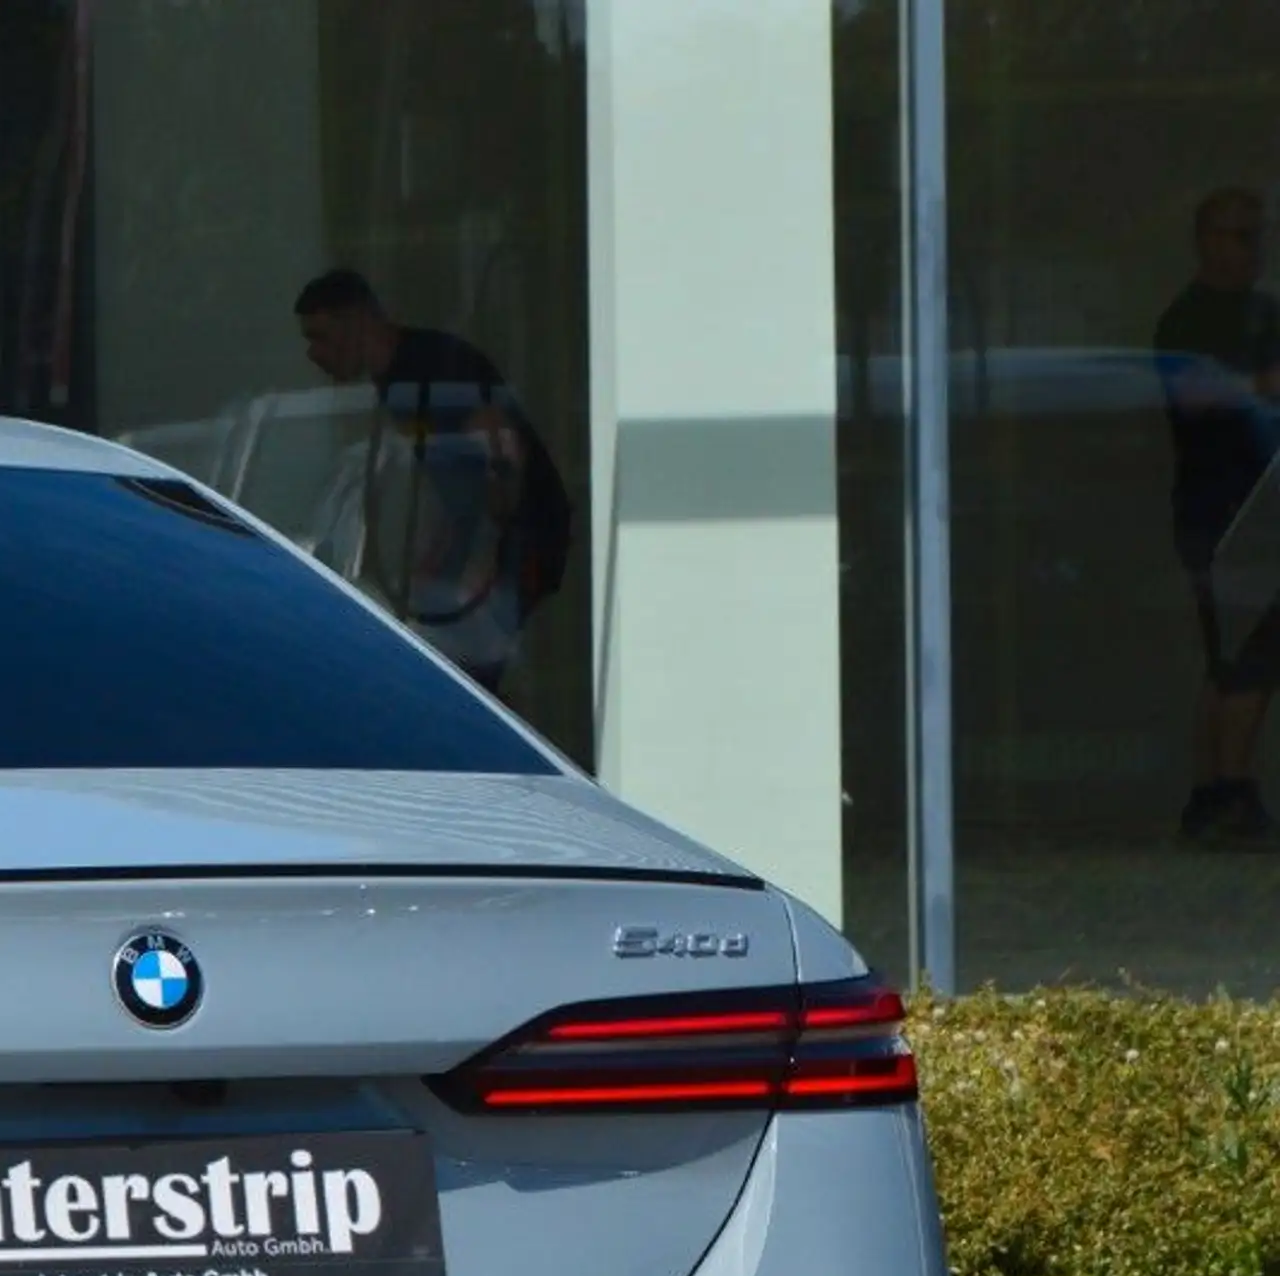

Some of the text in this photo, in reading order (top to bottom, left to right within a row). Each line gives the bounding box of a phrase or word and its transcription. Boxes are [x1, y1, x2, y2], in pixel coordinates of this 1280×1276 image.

[121, 933, 192, 964] BMW
[613, 926, 748, 958] 540d
[211, 1237, 325, 1256] Auto Gmbh
